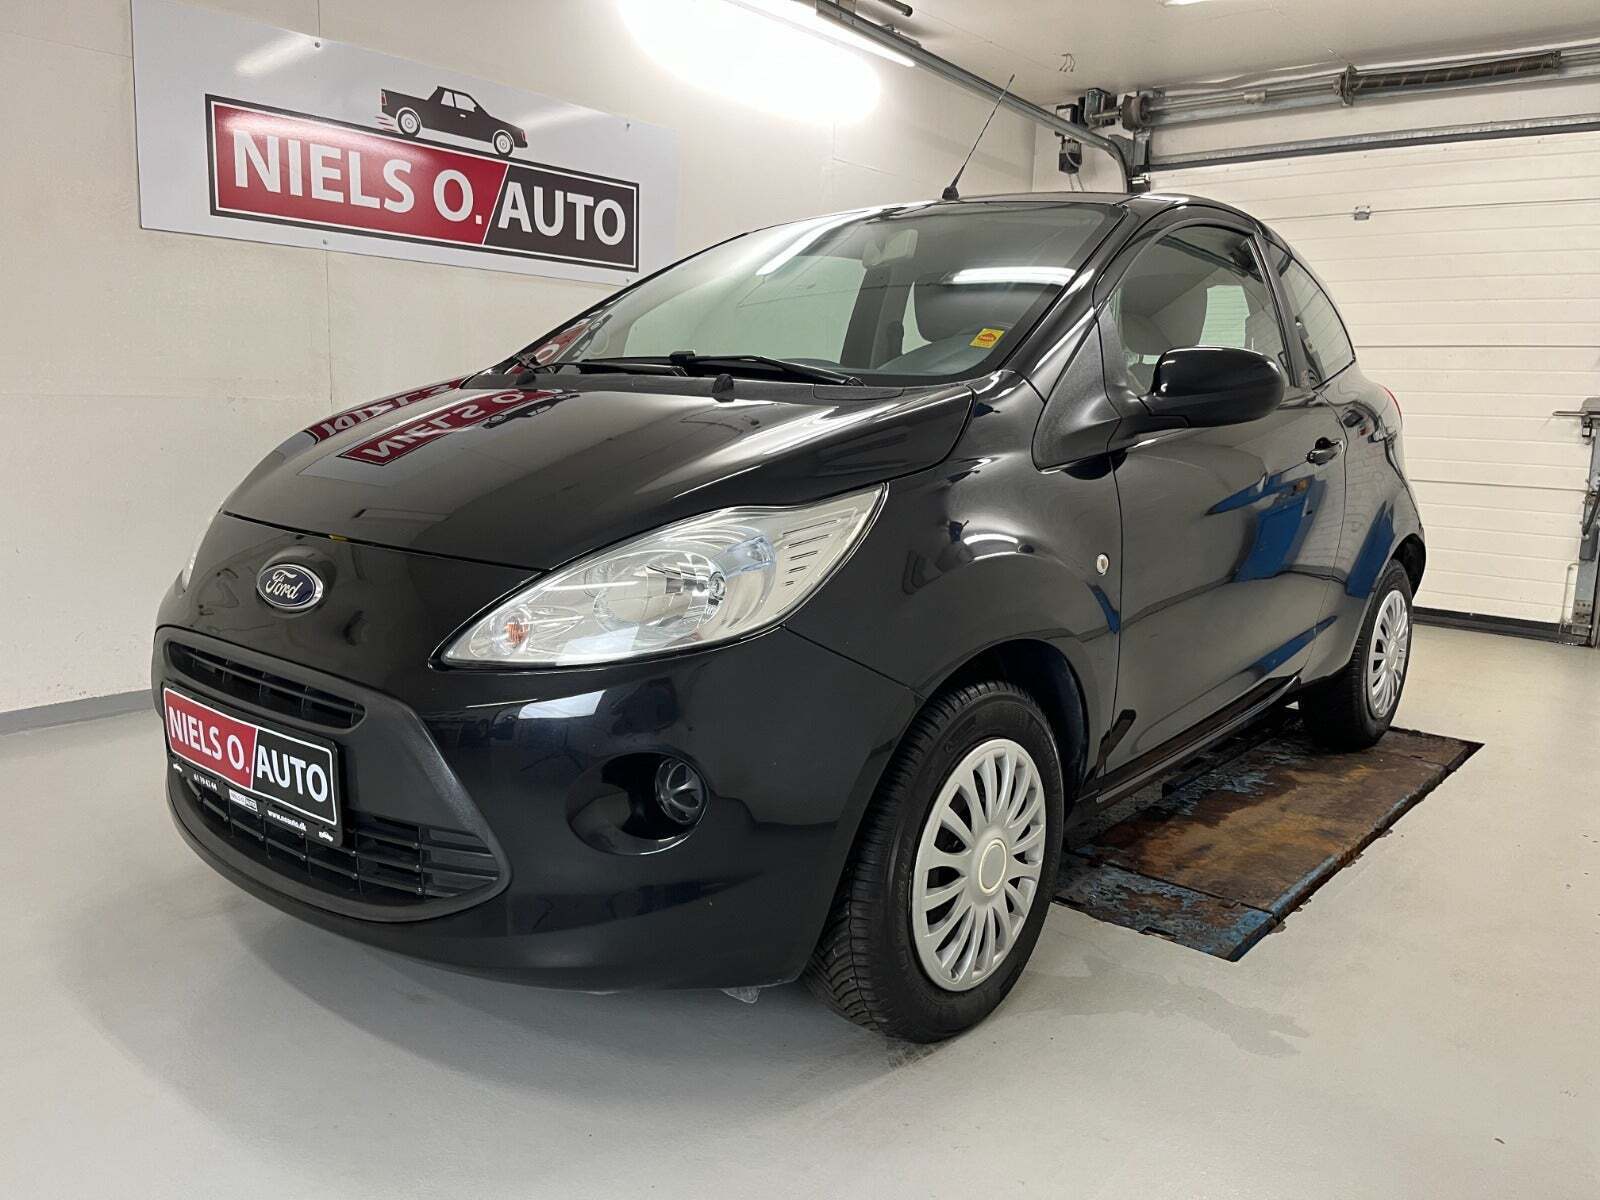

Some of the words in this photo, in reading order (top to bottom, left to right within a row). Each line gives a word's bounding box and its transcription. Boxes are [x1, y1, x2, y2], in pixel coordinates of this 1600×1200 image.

[233, 131, 415, 214] NIELS
[433, 169, 483, 225] O.
[497, 182, 627, 247] AUTO
[265, 569, 304, 599] Ford
[169, 706, 222, 761] NIELS
[227, 734, 250, 774] O.
[256, 744, 329, 803] AUTO
